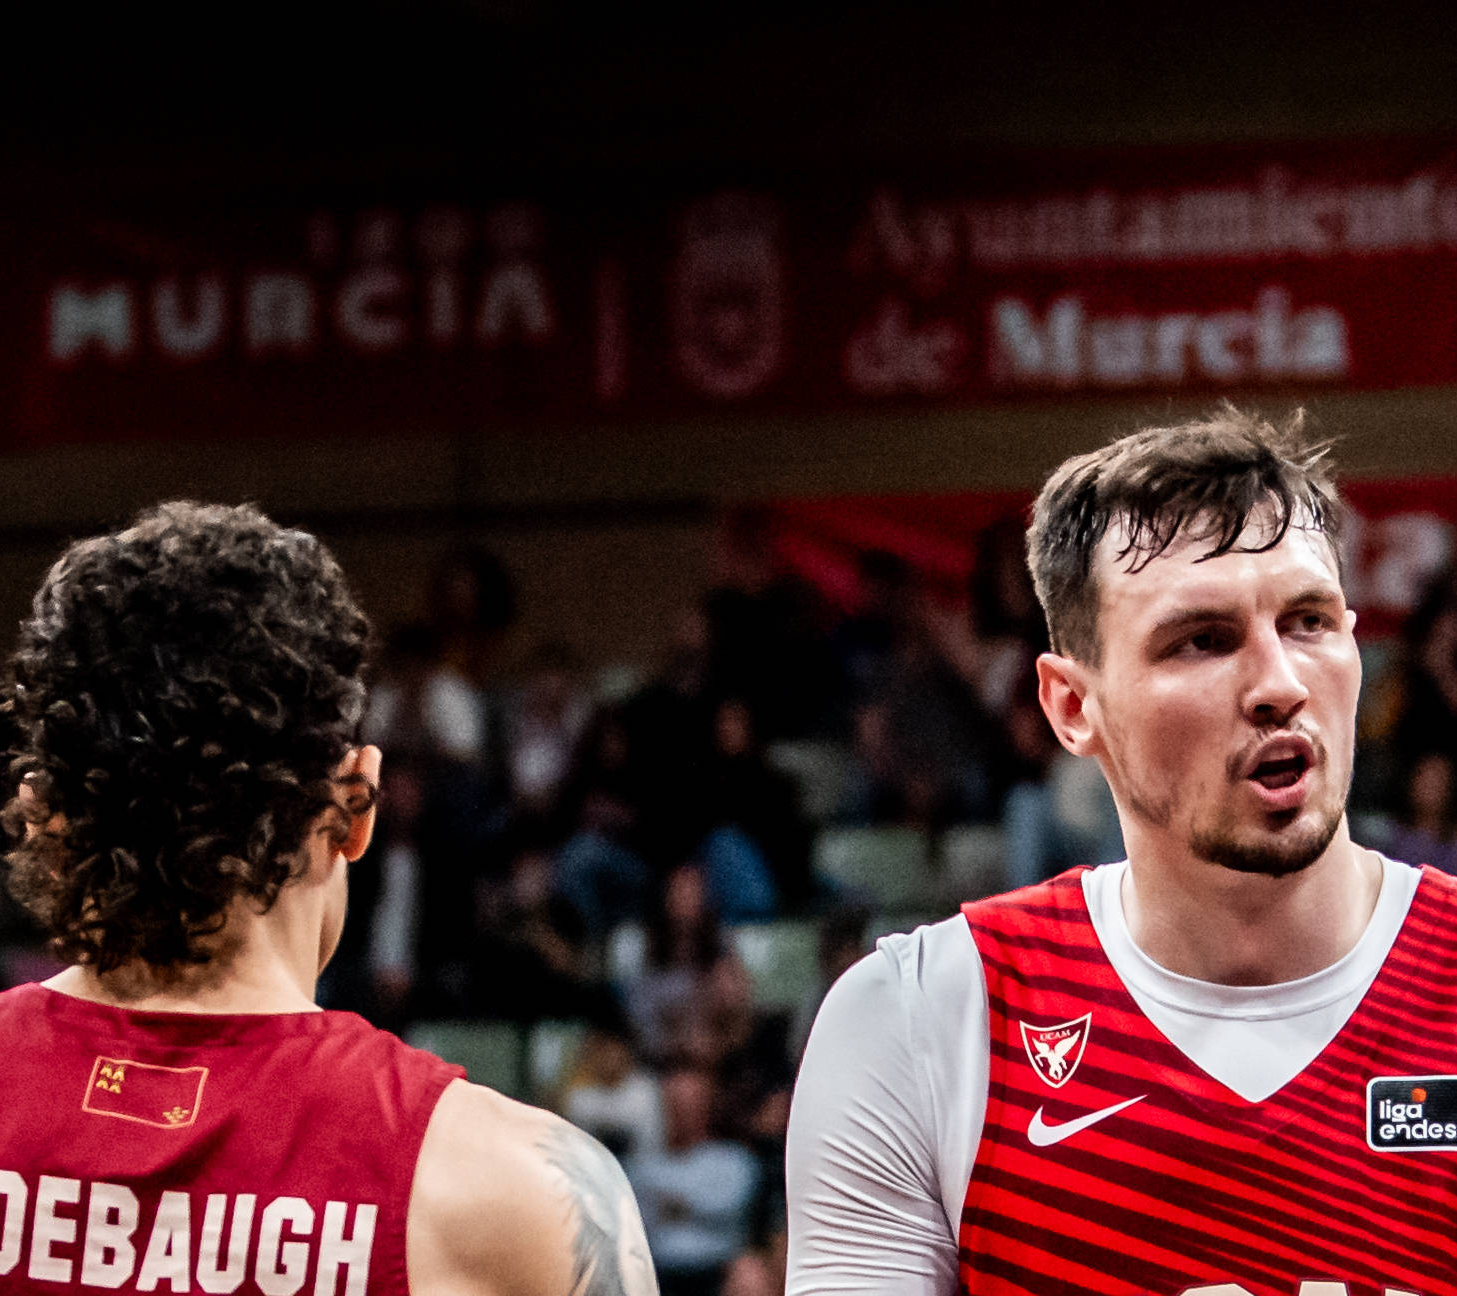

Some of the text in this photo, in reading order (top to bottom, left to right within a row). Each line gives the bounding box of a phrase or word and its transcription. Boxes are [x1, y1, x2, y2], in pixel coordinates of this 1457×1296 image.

[46, 262, 552, 365] MURCIA
[989, 287, 1349, 386] Murcia
[1039, 1029, 1071, 1041] UCAM
[1379, 1099, 1423, 1122] liga
